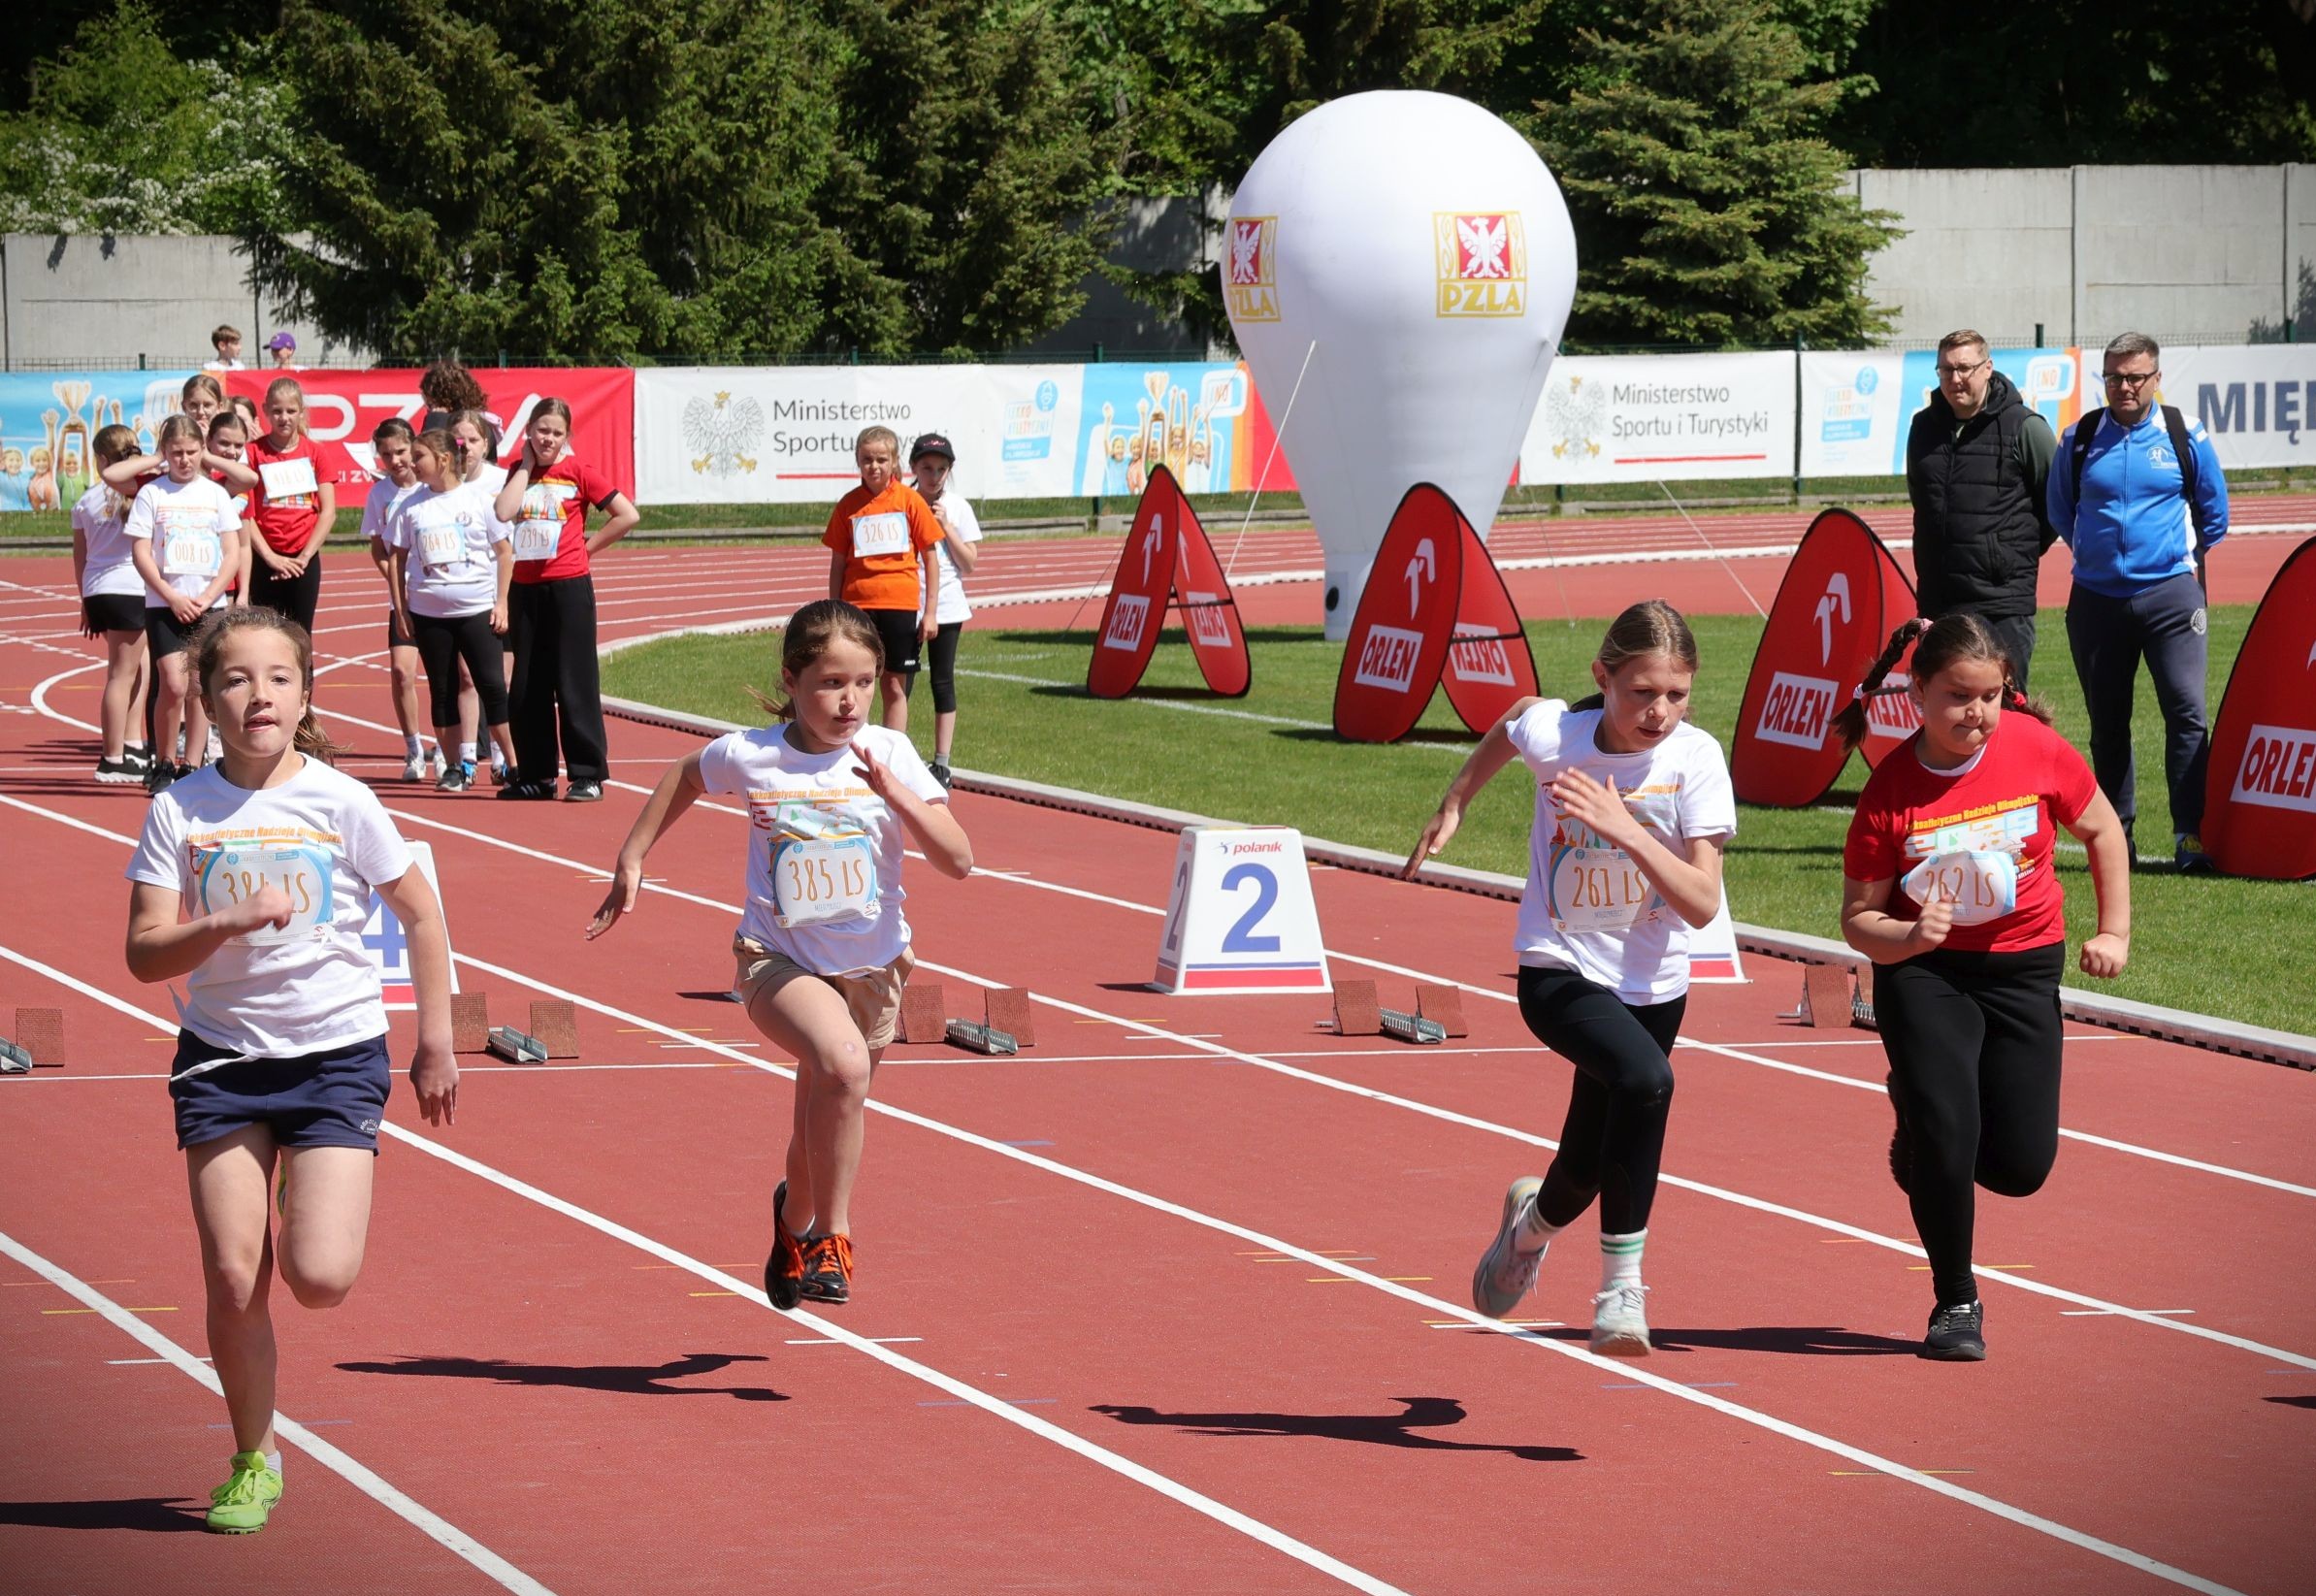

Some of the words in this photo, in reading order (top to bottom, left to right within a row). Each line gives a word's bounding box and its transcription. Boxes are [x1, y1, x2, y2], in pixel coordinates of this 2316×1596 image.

[1443, 283, 1520, 311] PZLA
[773, 399, 911, 421] Ministerstwo
[1613, 383, 1730, 405] Ministerstwo
[1613, 414, 1672, 440] Sportu
[1678, 412, 1683, 435] i
[1687, 410, 1768, 438] Turystyki
[773, 431, 854, 456] Sportu
[520, 528, 538, 548] 239
[863, 523, 884, 543] 326
[1109, 602, 1146, 642] ORLEN
[1361, 634, 1417, 682] ORLEN
[1763, 682, 1831, 739] ORLEN
[1233, 841, 1283, 856] polanik
[221, 871, 270, 904] 38
[788, 859, 833, 902] 385
[841, 859, 864, 896] LS
[1572, 865, 1615, 907] 261
[1624, 868, 1647, 904] LS
[1923, 866, 1964, 905] 262
[1973, 870, 1996, 907] LS
[1166, 861, 1189, 952] 2
[1221, 863, 1281, 953] 2
